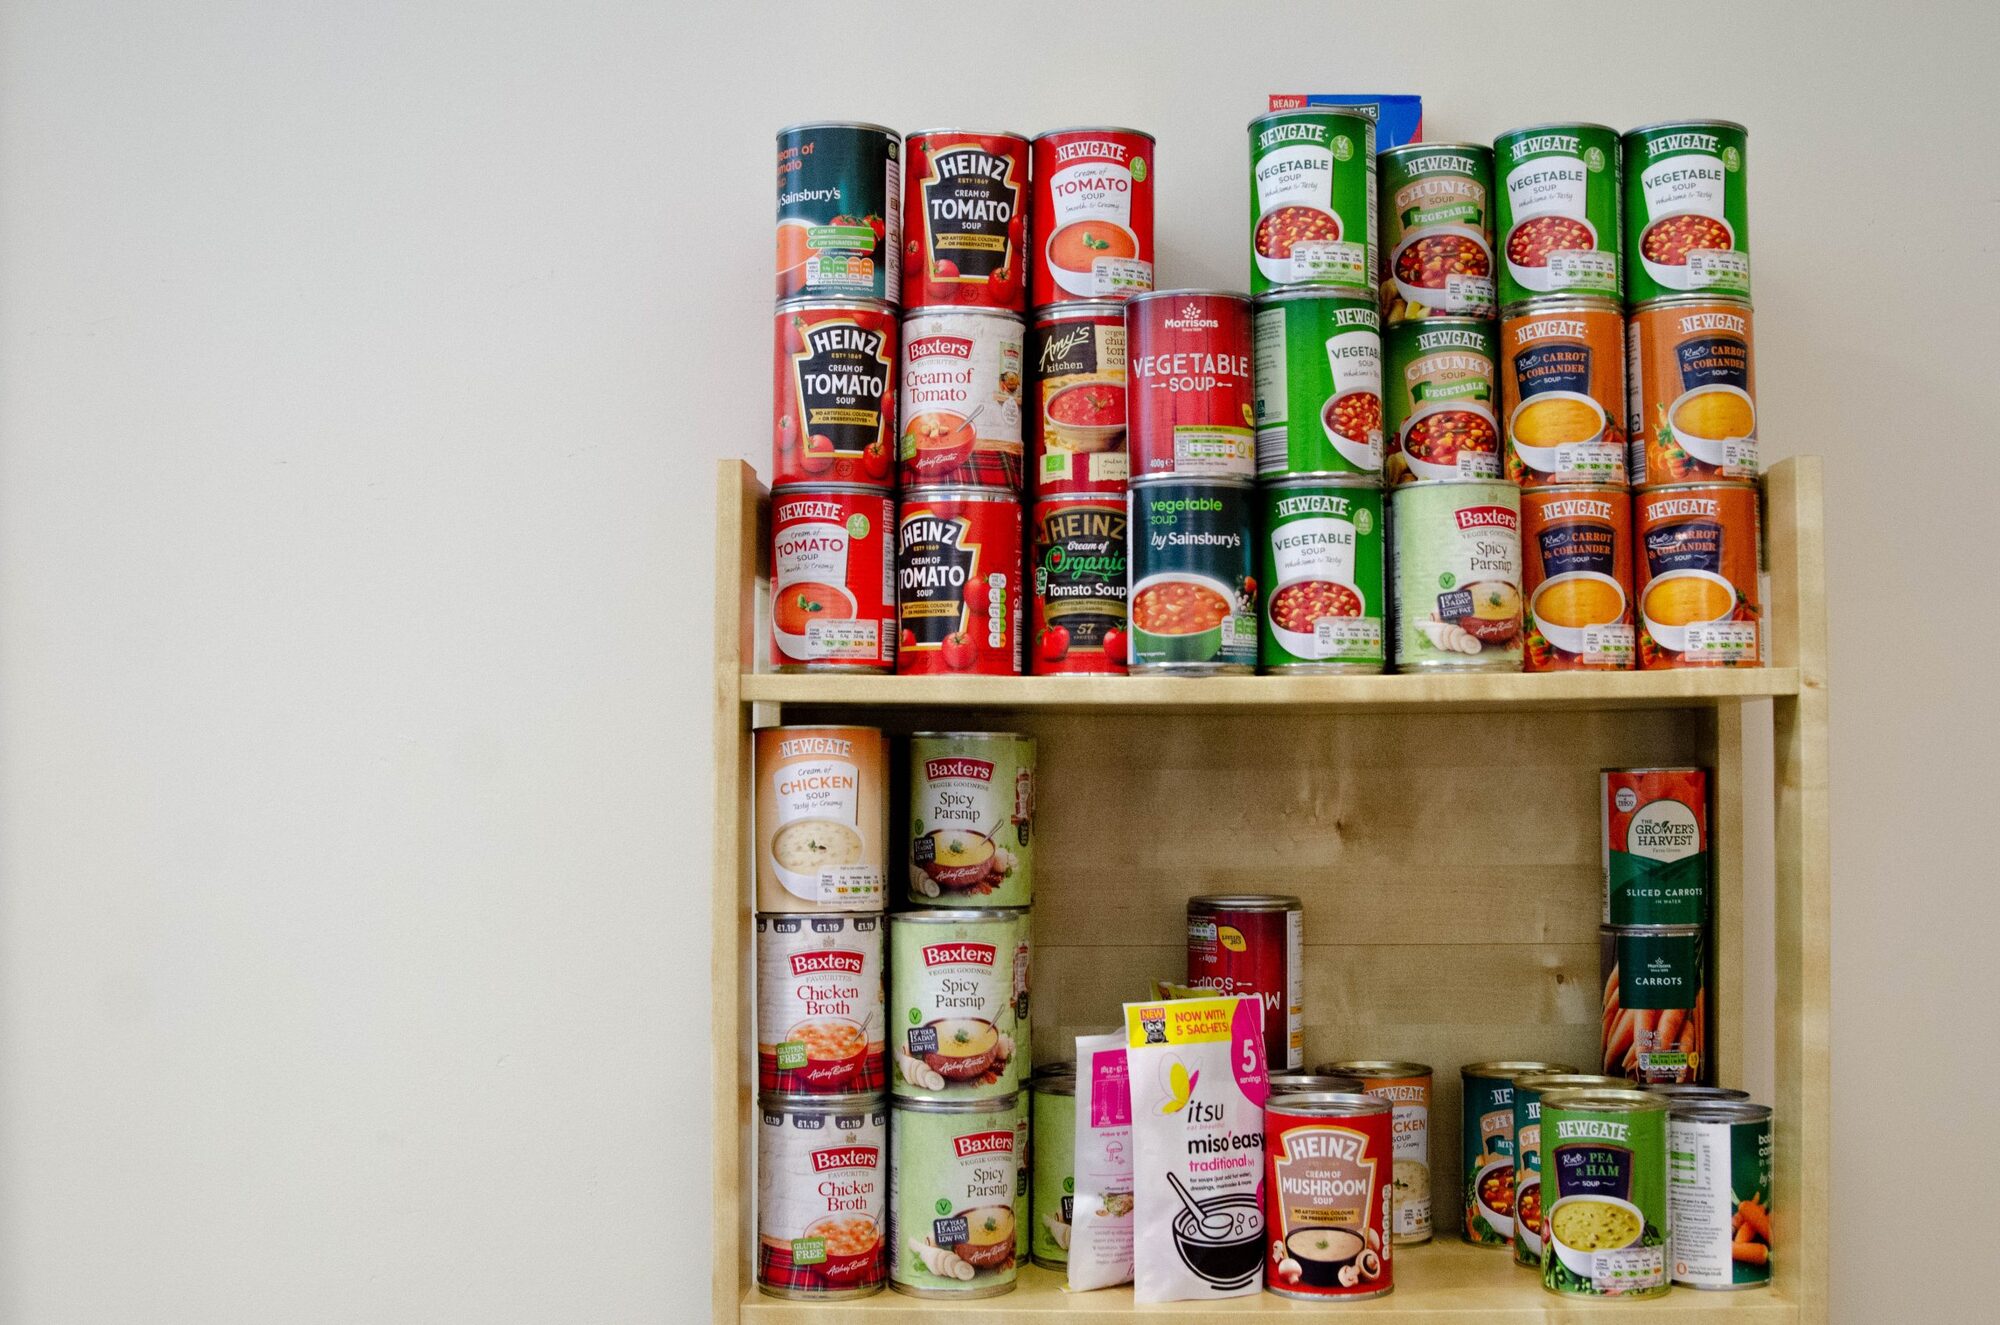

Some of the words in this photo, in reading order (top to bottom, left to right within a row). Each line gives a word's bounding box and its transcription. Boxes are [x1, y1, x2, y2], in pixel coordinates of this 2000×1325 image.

[1273, 100, 1300, 109] READY
[1260, 123, 1327, 150] NEWGATE
[801, 143, 815, 155] of
[1057, 141, 1127, 163] NEWGATE
[1512, 135, 1580, 160] NEWGATE
[1647, 133, 1718, 158] NEWGATE
[940, 154, 1006, 181] HEINZ
[1258, 160, 1328, 182] VEGETABLE
[1406, 155, 1475, 177] NEWGATE
[1279, 173, 1302, 184] SOUP
[1510, 170, 1583, 192] VEGETABLE
[1645, 169, 1722, 190] VEGETABLE
[955, 189, 979, 198] CREAM
[981, 190, 990, 198] OF
[1056, 178, 1128, 197] TOMATO
[1398, 180, 1484, 207] CHUNKY
[1533, 184, 1557, 194] SOUP
[1672, 182, 1697, 192] SOUP
[781, 187, 841, 206] Sainsbury's
[1081, 193, 1105, 201] SOUP
[1429, 195, 1455, 205] SOUP
[931, 199, 1011, 222] TOMATO
[1413, 205, 1475, 222] VEGETABLE
[962, 222, 982, 230] SOUP
[1165, 318, 1218, 331] Morrisons
[1334, 308, 1380, 330] NEWGA
[1680, 313, 1745, 335] NEWGATE
[1416, 329, 1485, 351] NEWGATE
[1516, 319, 1585, 345] NEWGATE
[813, 329, 878, 356] HEINZ
[910, 339, 969, 359] Baxters
[1038, 326, 1090, 373] Amy's
[1543, 352, 1587, 363] CARROT
[1711, 345, 1746, 357] CARROT
[829, 364, 853, 374] CREAM
[854, 365, 864, 374] OF
[1047, 359, 1083, 374] kitchen
[1106, 357, 1125, 365] sou
[1133, 353, 1249, 379] VEGETABLE
[1407, 355, 1493, 381] CHUNKY
[1693, 358, 1745, 371] CORIANDER
[906, 371, 953, 388] Cream
[956, 368, 974, 385] of
[1440, 371, 1466, 383] SOUP
[1526, 364, 1585, 379] CORIANDER
[1711, 368, 1728, 376] SOUP
[805, 374, 883, 398] TOMATO
[1169, 377, 1215, 391] SOUP
[1543, 376, 1561, 384] SOUP
[910, 388, 967, 404] Tomato
[1425, 381, 1484, 400] VEGETABLE
[836, 397, 856, 405] SOUP
[779, 501, 842, 522] NEWGATE
[1150, 498, 1223, 514] vegetable
[1277, 495, 1350, 518] NEWGATE
[1541, 500, 1612, 520] NEWGATE
[1647, 499, 1718, 521] NEWGATE
[1150, 514, 1177, 526] soup
[1459, 510, 1516, 528] Baxters
[903, 521, 957, 548] HEINZ
[1051, 514, 1127, 541] HEINZ
[1151, 535, 1167, 549] by
[1168, 532, 1240, 549] Sainsbury's
[1275, 533, 1352, 551] VEGETABLE
[1571, 531, 1612, 543] CARROT
[776, 538, 844, 558] TOMATO
[1067, 541, 1097, 551] Cream
[1301, 547, 1326, 557] SOUP
[1476, 541, 1507, 559] Spicy
[1553, 545, 1611, 558] CORIANDER
[1656, 543, 1716, 558] CORIANDER
[797, 553, 819, 562] SOUP
[911, 557, 930, 567] CREAM
[931, 556, 941, 566] OF
[1045, 545, 1126, 581] Organic
[1470, 557, 1512, 574] Parsnip
[1571, 556, 1590, 564] SOUP
[1674, 554, 1692, 562] SOUP
[900, 566, 965, 589] TOMATO
[917, 589, 934, 598] SOUP
[1048, 582, 1092, 598] Tomato
[1095, 583, 1127, 599] Soup
[1077, 621, 1096, 635] 57
[780, 738, 853, 759] NEWGATE
[798, 766, 821, 777] Cream
[928, 762, 990, 781] Baxters
[780, 776, 853, 796] CHICKEN
[806, 791, 831, 801] SOUP
[940, 792, 975, 809] Spicy
[934, 807, 981, 823] Parsnip
[1635, 822, 1694, 836] GROWER'S
[1638, 836, 1693, 847] HARVEST
[1626, 888, 1661, 897] SLICED
[1665, 887, 1703, 897] CARROTS
[777, 922, 797, 932] £1.19
[817, 922, 841, 932] £1.19
[858, 921, 875, 931] £1.19
[794, 954, 862, 974] Baxters
[926, 947, 993, 965] Baxters
[957, 966, 992, 976] GOODNESS
[941, 977, 979, 995] Spicy
[1636, 977, 1682, 986] CARROTS
[796, 984, 860, 1001] Chicken
[806, 1000, 851, 1015] Broth
[935, 994, 985, 1010] Parsnip
[1141, 1009, 1165, 1020] NEW
[1175, 1011, 1202, 1023] NOW
[1204, 1009, 1226, 1021] WITH
[1176, 1025, 1184, 1036] 5
[780, 1053, 805, 1064] FREE
[1242, 1039, 1257, 1073] 5
[1240, 1075, 1261, 1085] servings
[1187, 1100, 1224, 1123] itsu
[797, 1118, 821, 1129] £1.19
[841, 1118, 861, 1128] £1.19
[1394, 1119, 1426, 1137] CKEN
[1557, 1119, 1630, 1141] NEWGATE
[959, 1135, 1013, 1155] Baxters
[1291, 1136, 1358, 1161] HEINZ
[817, 1150, 877, 1170] Baxters
[1189, 1154, 1247, 1173] traditional
[1589, 1153, 1614, 1164] PEA
[973, 1167, 1004, 1185] Spicy
[1305, 1171, 1330, 1179] CREAM
[1332, 1171, 1342, 1179] OF
[1586, 1165, 1619, 1178] HAM
[818, 1180, 874, 1198] Chicken
[1198, 1177, 1213, 1185] soups
[1282, 1178, 1367, 1196] MUSHROOM
[1582, 1180, 1600, 1188] SOUP
[967, 1182, 1008, 1199] Parsnip
[827, 1196, 867, 1213] Broth
[940, 1202, 948, 1212] V
[1313, 1197, 1334, 1206] SOUP
[793, 1241, 823, 1251] GLUTEN
[796, 1248, 826, 1261] FREE
